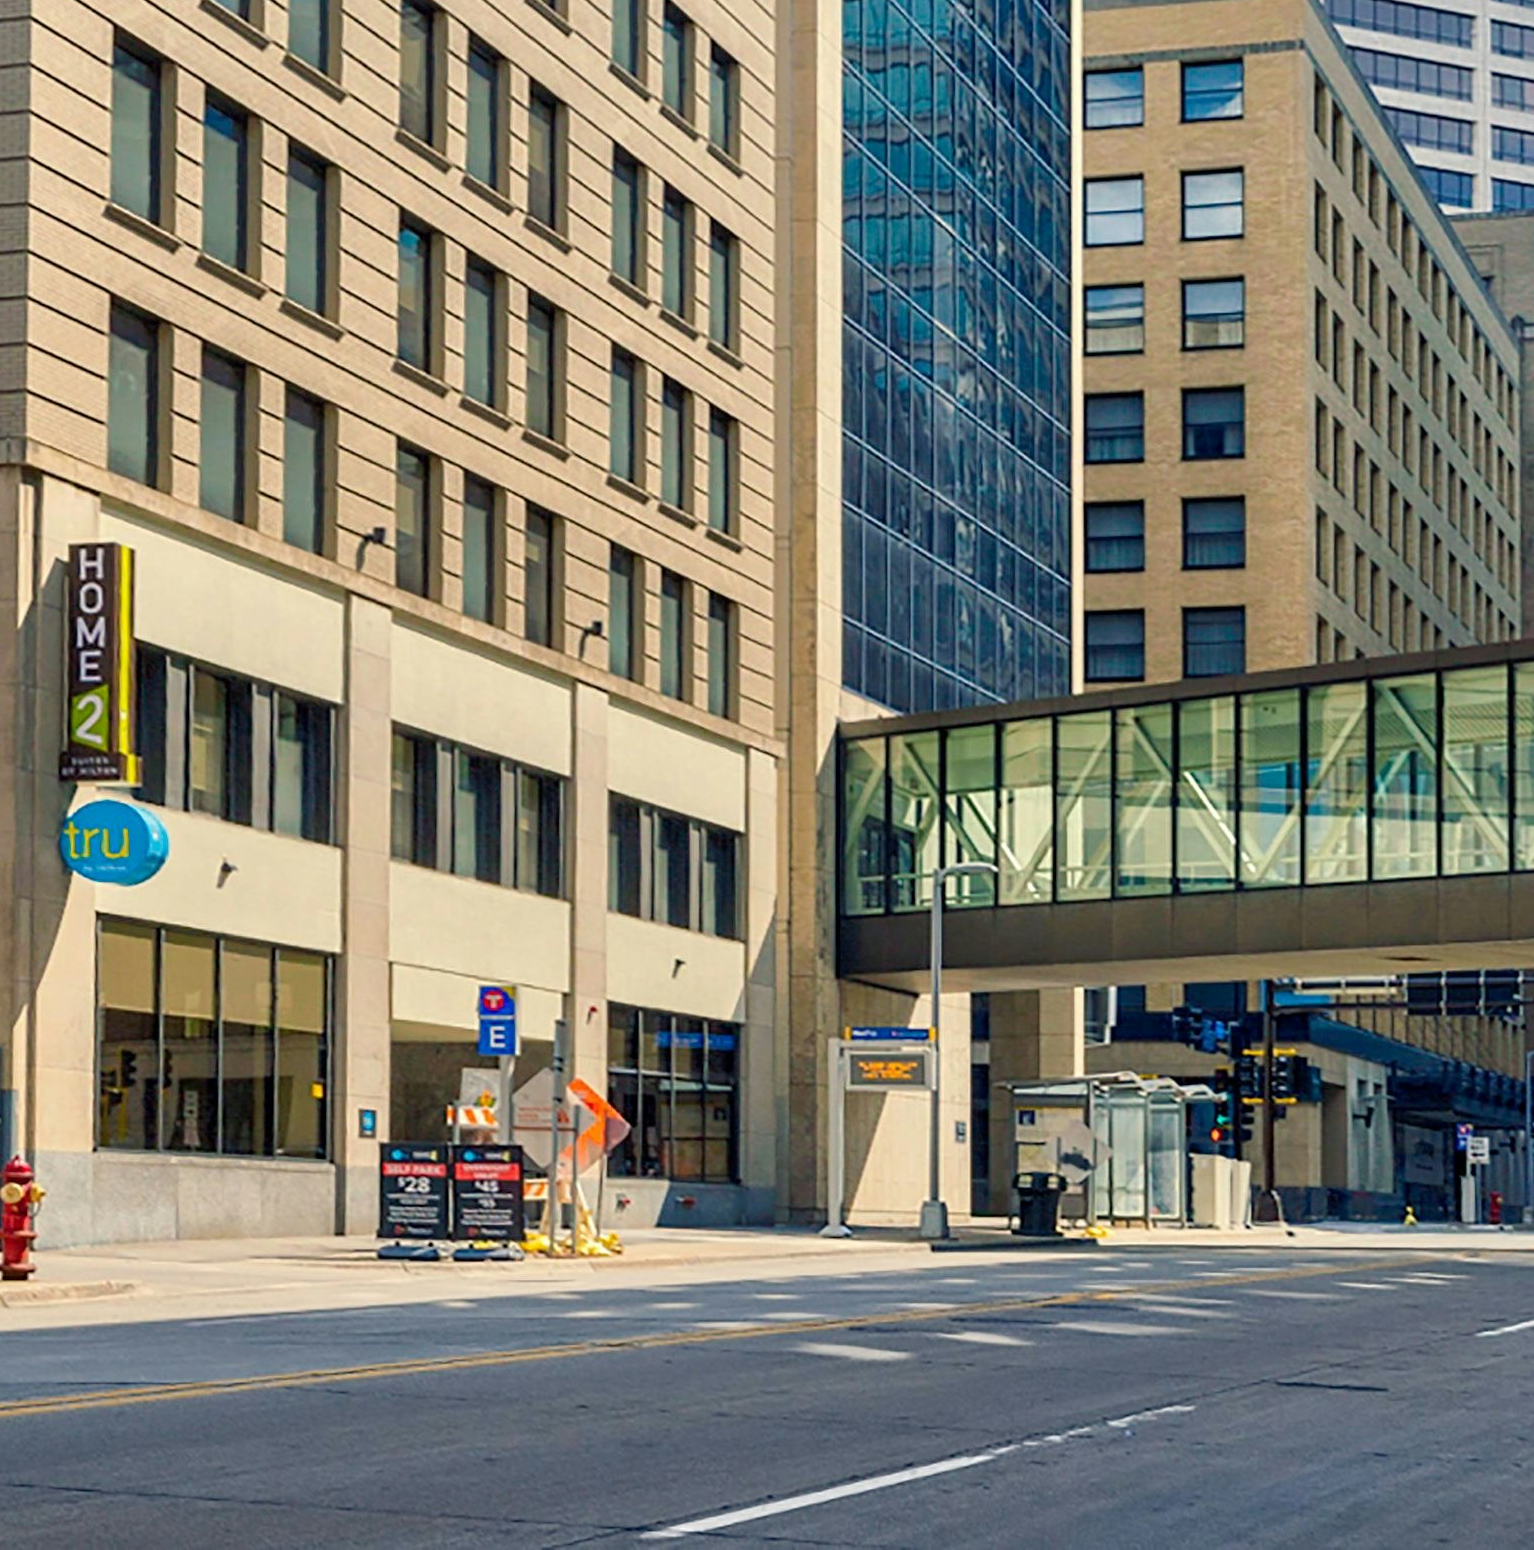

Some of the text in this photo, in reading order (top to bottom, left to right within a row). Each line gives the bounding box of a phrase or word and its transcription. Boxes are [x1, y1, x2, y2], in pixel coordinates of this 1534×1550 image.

[64, 821, 129, 859] tru
[489, 1025, 506, 1048] E
[397, 1176, 431, 1193] $28
